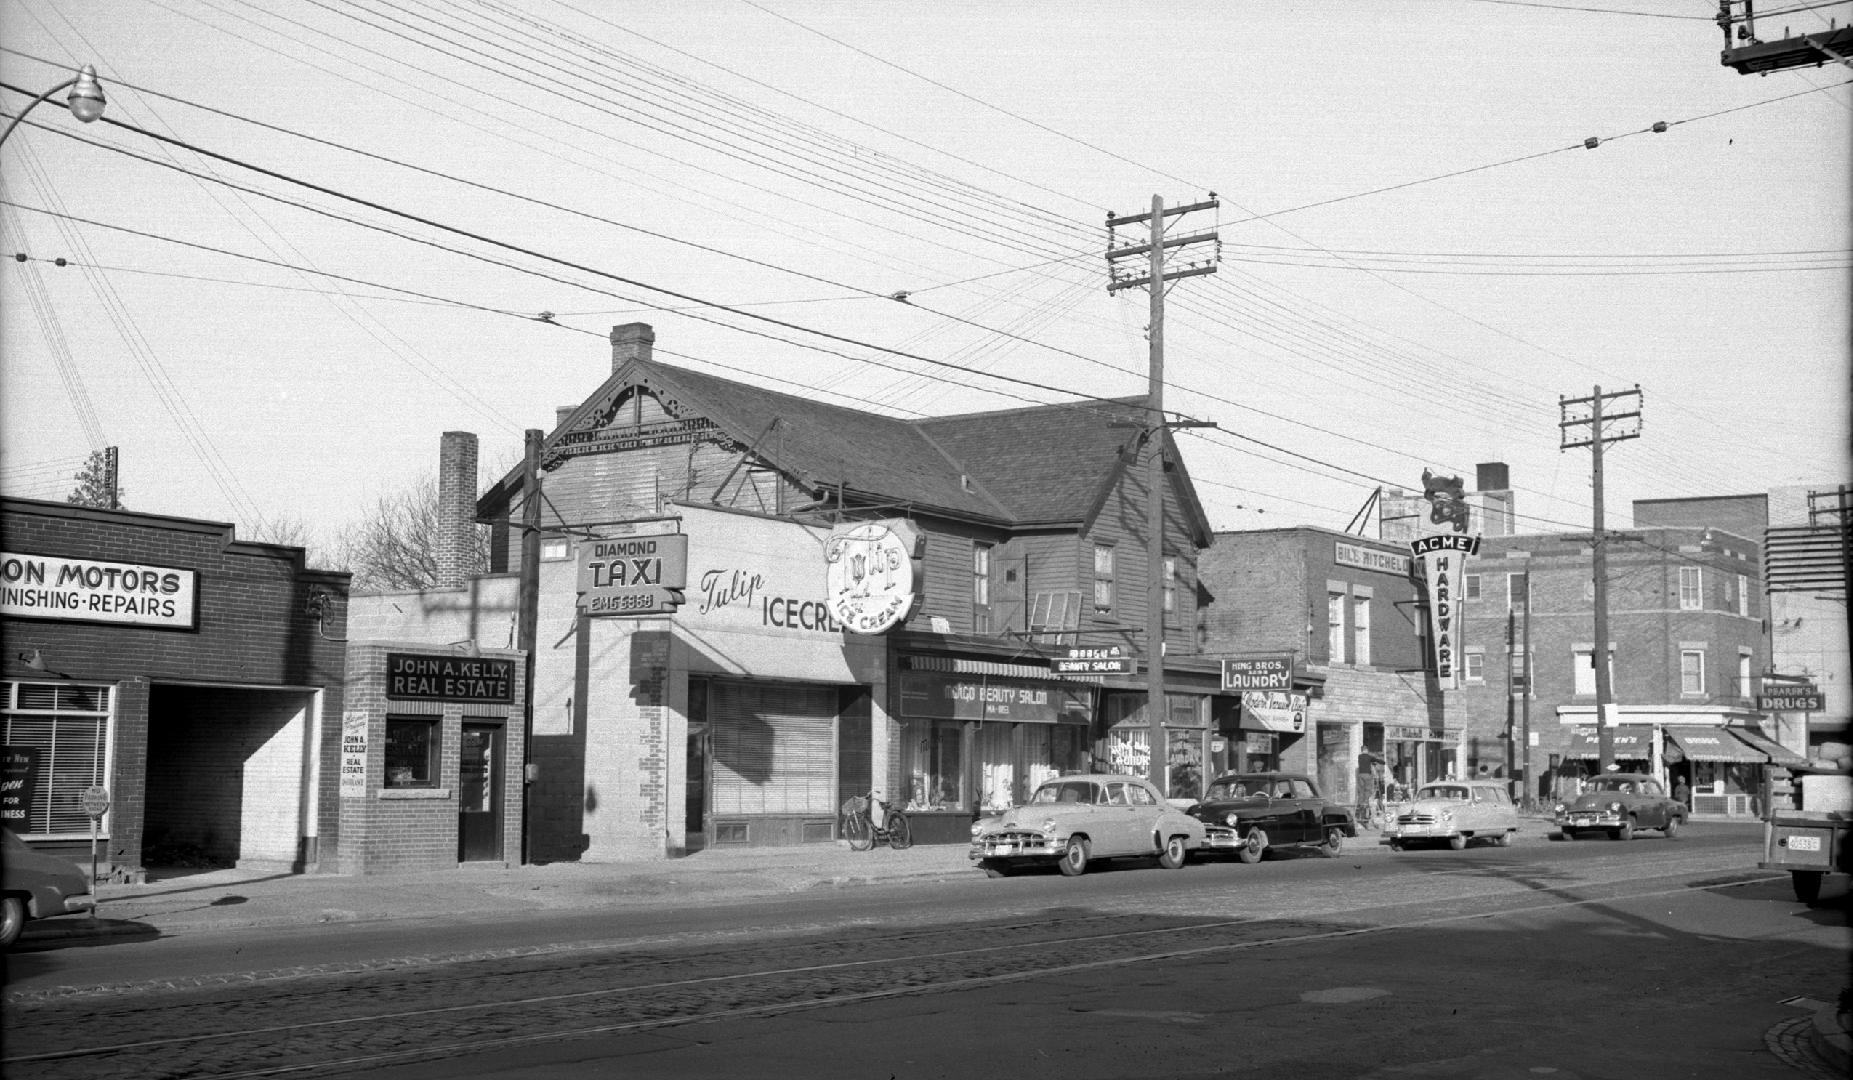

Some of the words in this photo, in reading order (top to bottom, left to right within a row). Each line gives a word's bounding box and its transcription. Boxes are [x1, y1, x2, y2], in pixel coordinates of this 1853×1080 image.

[594, 541, 657, 558] DIAMOND
[1418, 537, 1468, 553] ACME
[0, 558, 45, 585] ON
[55, 564, 181, 595] MOTORS
[588, 557, 662, 588] TAXI
[699, 568, 766, 615] Tulip
[837, 599, 856, 625] ICE
[860, 596, 903, 630] CREAM
[1436, 556, 1452, 678] HARDWARE
[394, 659, 439, 674] JOHN
[1092, 661, 1121, 671] SALON
[1255, 661, 1285, 670] BROS.
[394, 677, 439, 694] REAL
[445, 680, 507, 697] ESTATE
[1226, 670, 1290, 688] LAUNDRY
[980, 687, 1015, 703] BEAUTY
[1019, 690, 1048, 705] SALON
[1761, 697, 1818, 709] DRUGS
[343, 735, 359, 744] JOHN
[343, 745, 367, 753] KELLY
[342, 766, 364, 774] ESTATE
[346, 758, 361, 766] REAL
[3, 797, 20, 805] FOR
